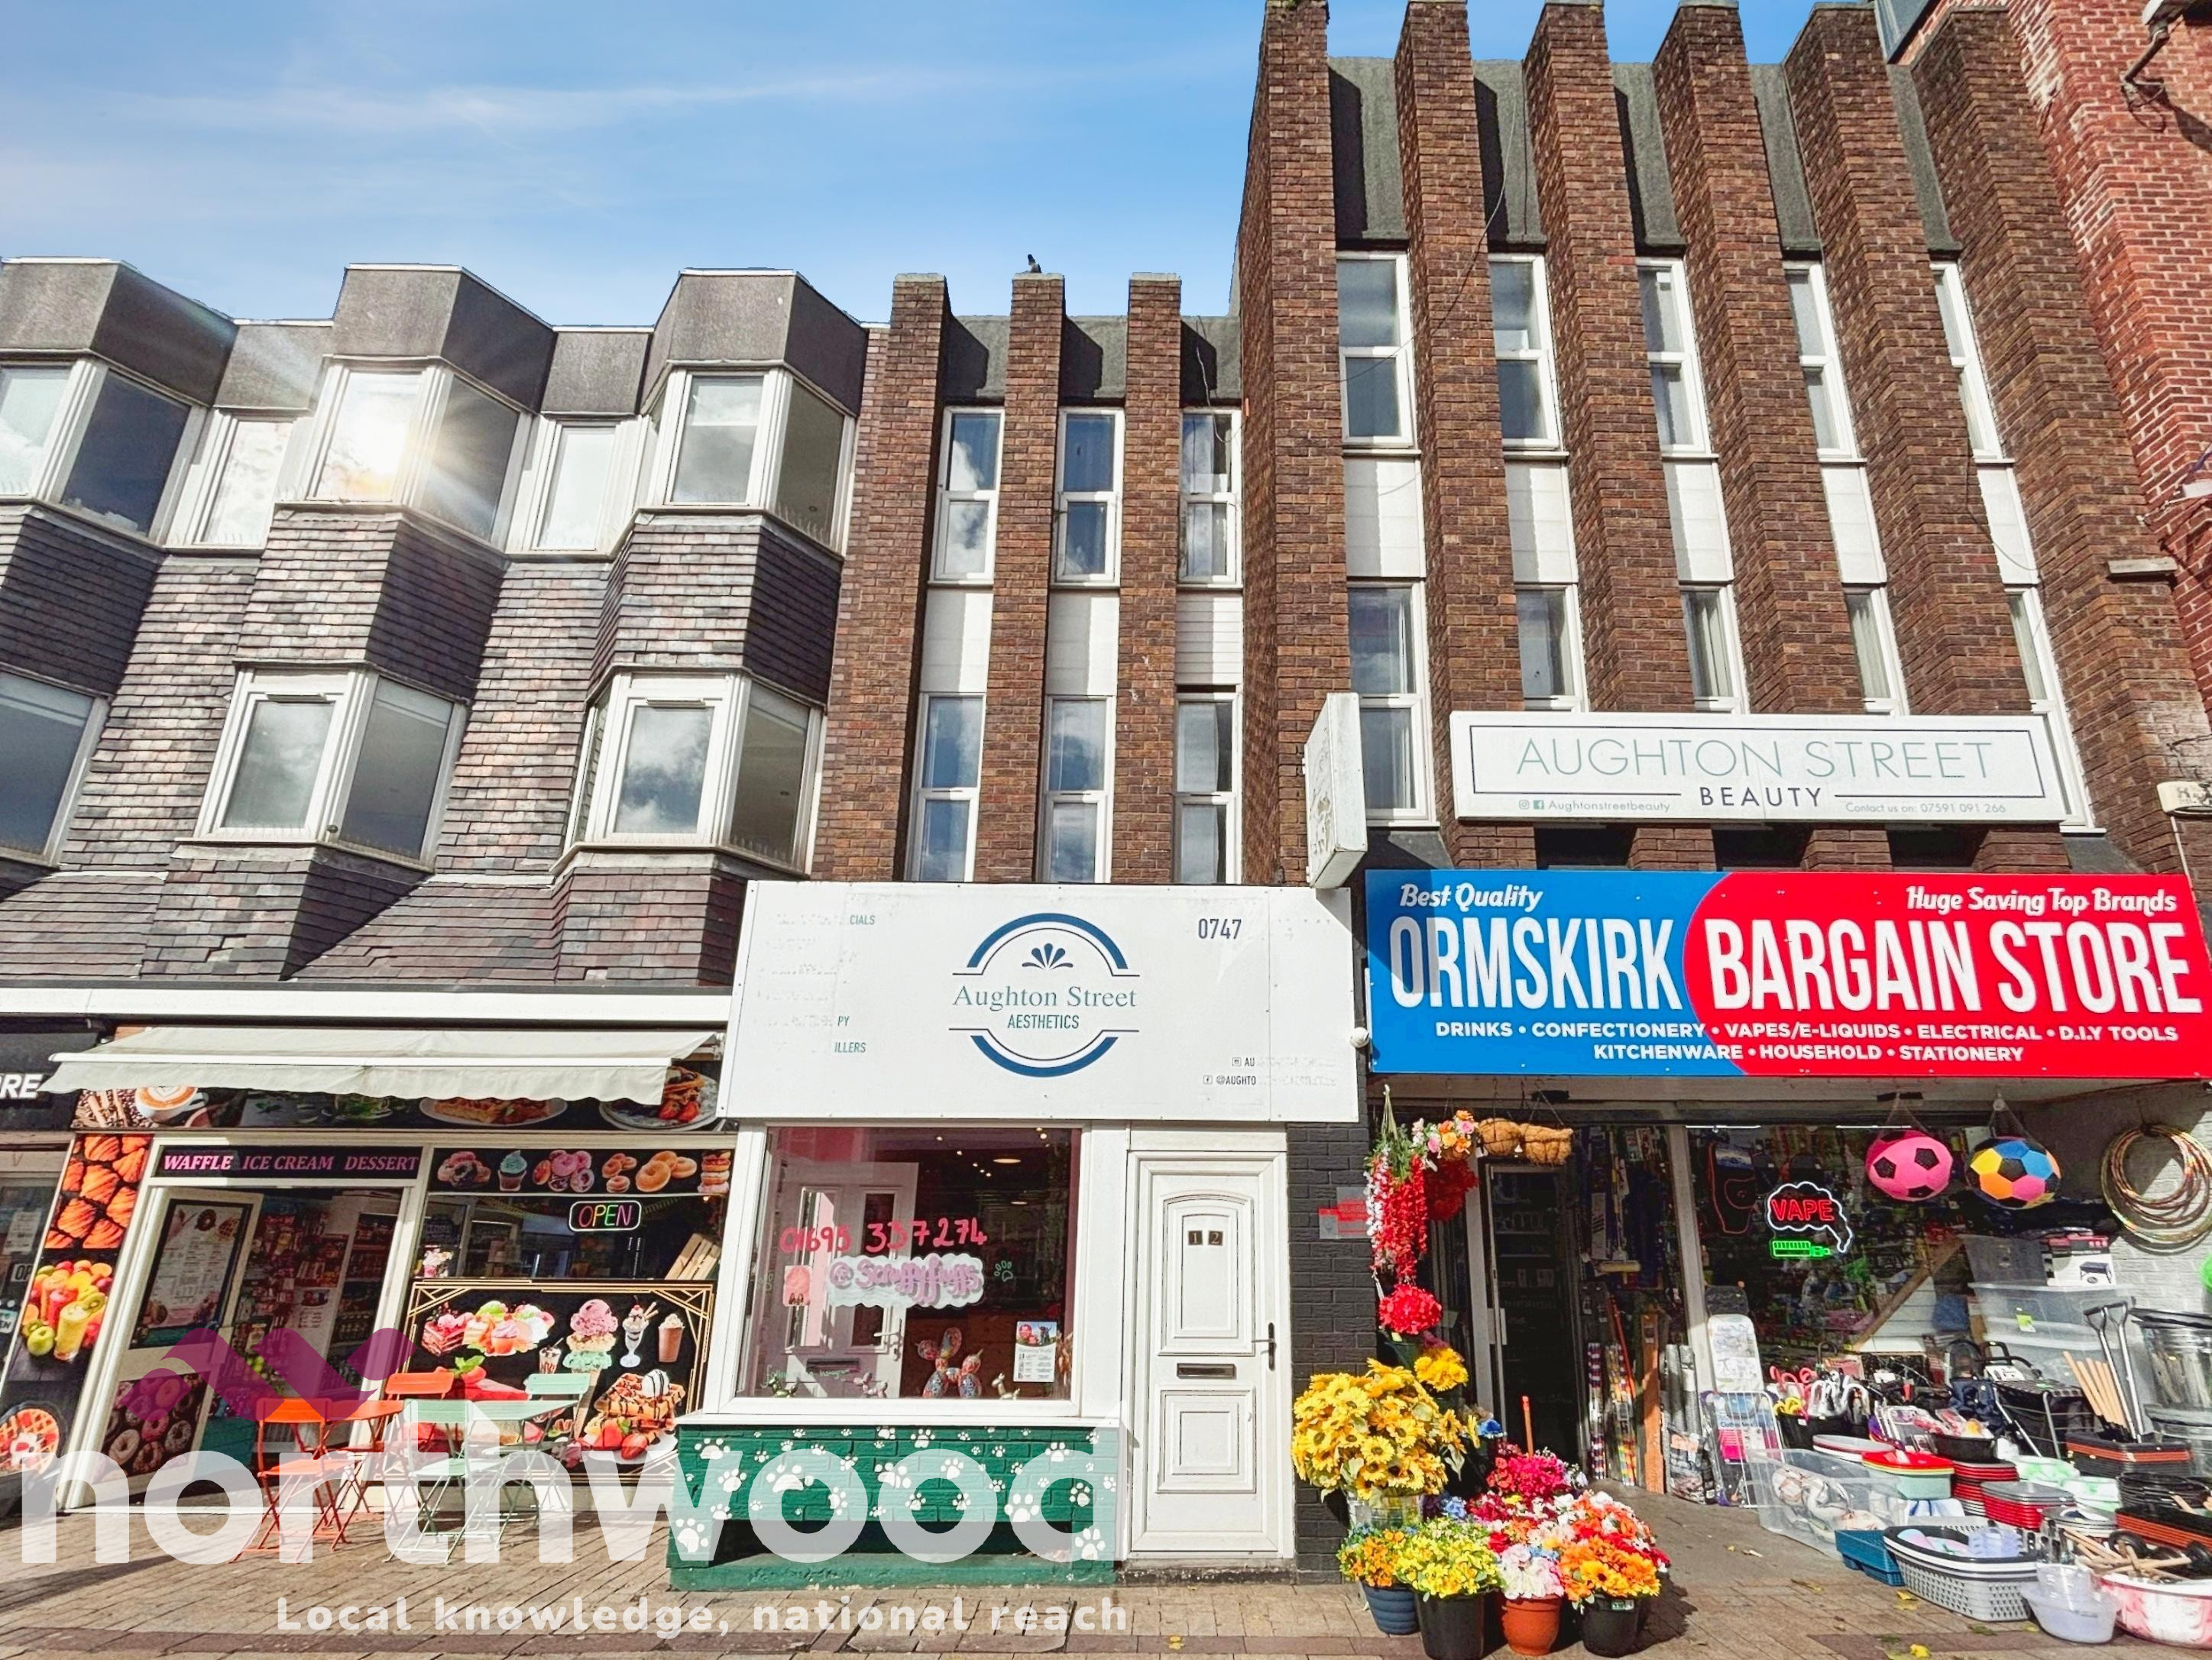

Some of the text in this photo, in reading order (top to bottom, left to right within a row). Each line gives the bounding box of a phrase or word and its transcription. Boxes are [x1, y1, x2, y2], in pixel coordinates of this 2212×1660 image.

[1517, 738, 1993, 779] AUGHTON STREET
[1548, 800, 1671, 813] Aughtonstreetbeauty
[1699, 786, 1823, 807] BEAUTY
[1846, 802, 1884, 813] Contact
[1921, 803, 1955, 814] 07591
[1959, 803, 1980, 814] 091
[1985, 803, 2006, 814] 266
[1400, 882, 1543, 912] Best Quality
[1906, 885, 2178, 917] Huge Saving Top Brands
[849, 914, 876, 925] CIALS
[1198, 918, 1242, 940] 0747
[1389, 916, 2204, 1014] ORMSKIRK BARGAIN STORE
[953, 985, 1138, 1012] Aughton Street
[1007, 1014, 1080, 1030] AESTHETICS
[1436, 1021, 1514, 1037] DRINKS
[1531, 1022, 1706, 1038] CONFECTIONERY
[1724, 1021, 1901, 1040] VAPES/E-LIQUIDS
[1917, 1024, 2043, 1040] ELECTRICAL
[2107, 1026, 2179, 1041] TOOLS
[1593, 1044, 2025, 1062] KITCHENWARE HOUSEHOLD STATIONERY
[0, 1073, 44, 1100] RE
[164, 1155, 419, 1171] WAFFLE ICE CREAM DESSERT
[578, 1204, 633, 1228] OPEN
[1771, 1199, 1835, 1222] VAPE
